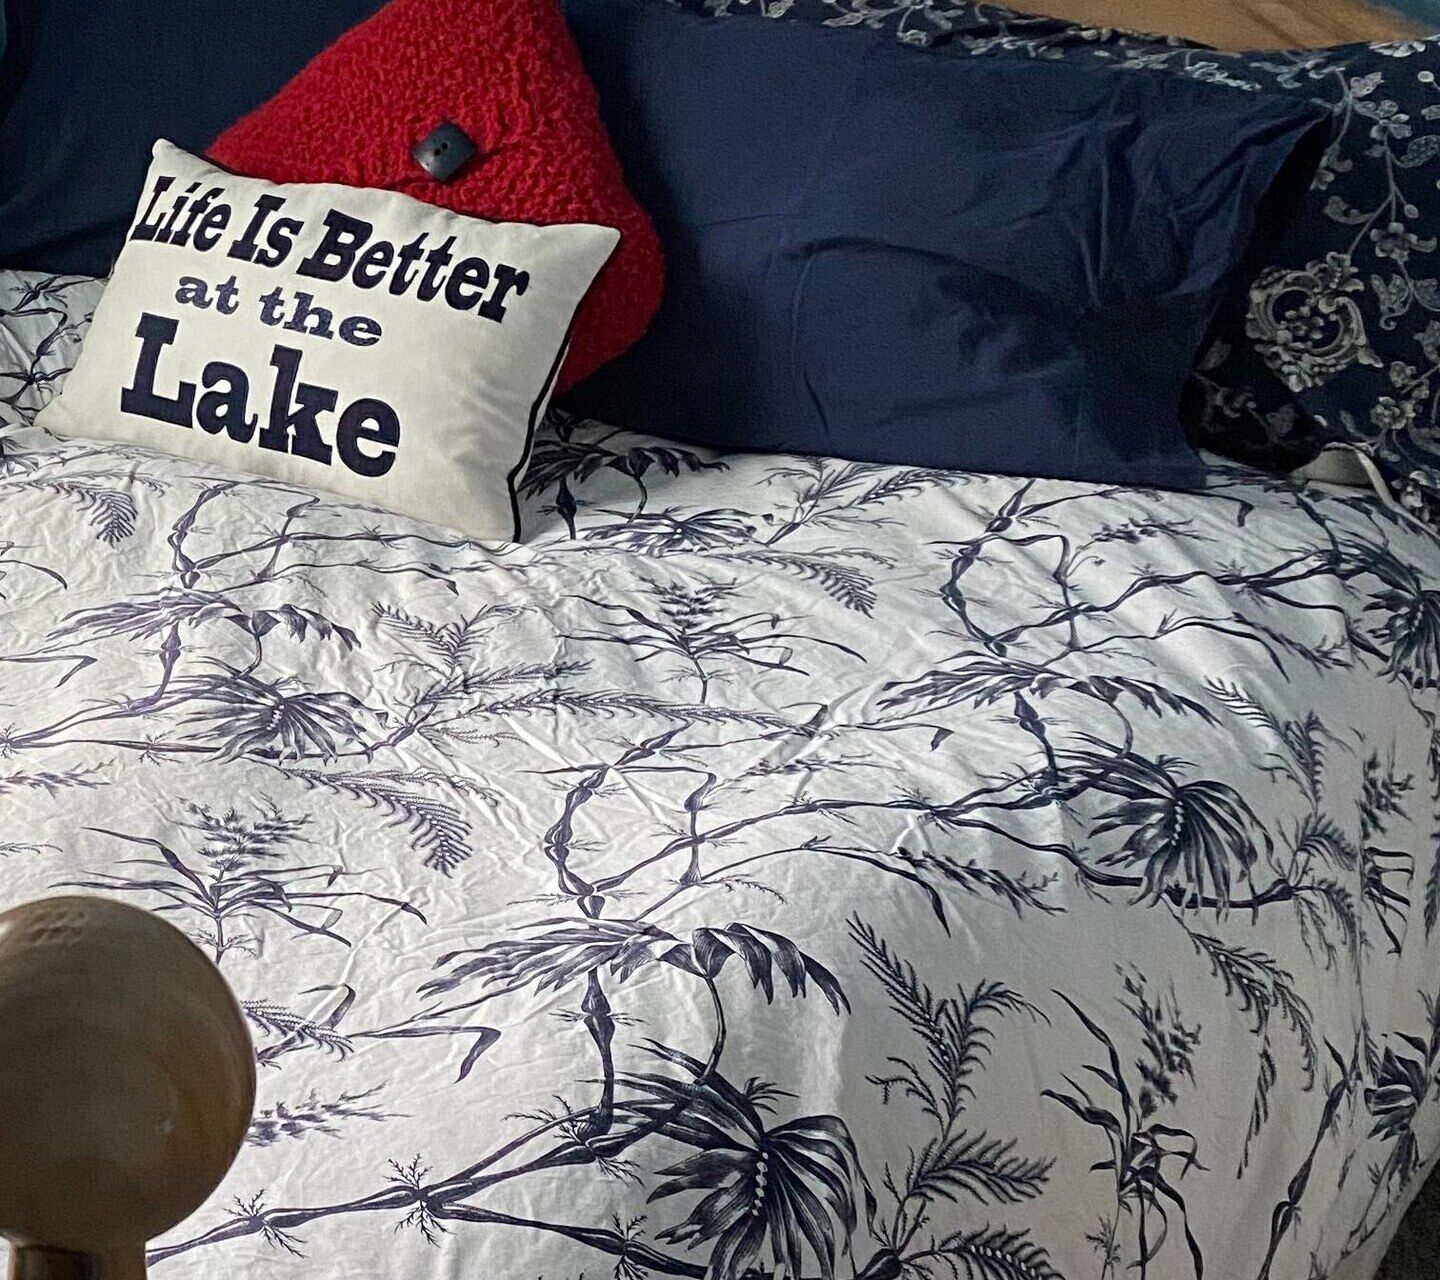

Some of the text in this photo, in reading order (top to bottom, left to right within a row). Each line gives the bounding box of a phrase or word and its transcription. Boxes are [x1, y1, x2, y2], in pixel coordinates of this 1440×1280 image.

[128, 175, 530, 323] Life Is Better
[174, 273, 383, 347] at the
[120, 312, 401, 478] Lake
